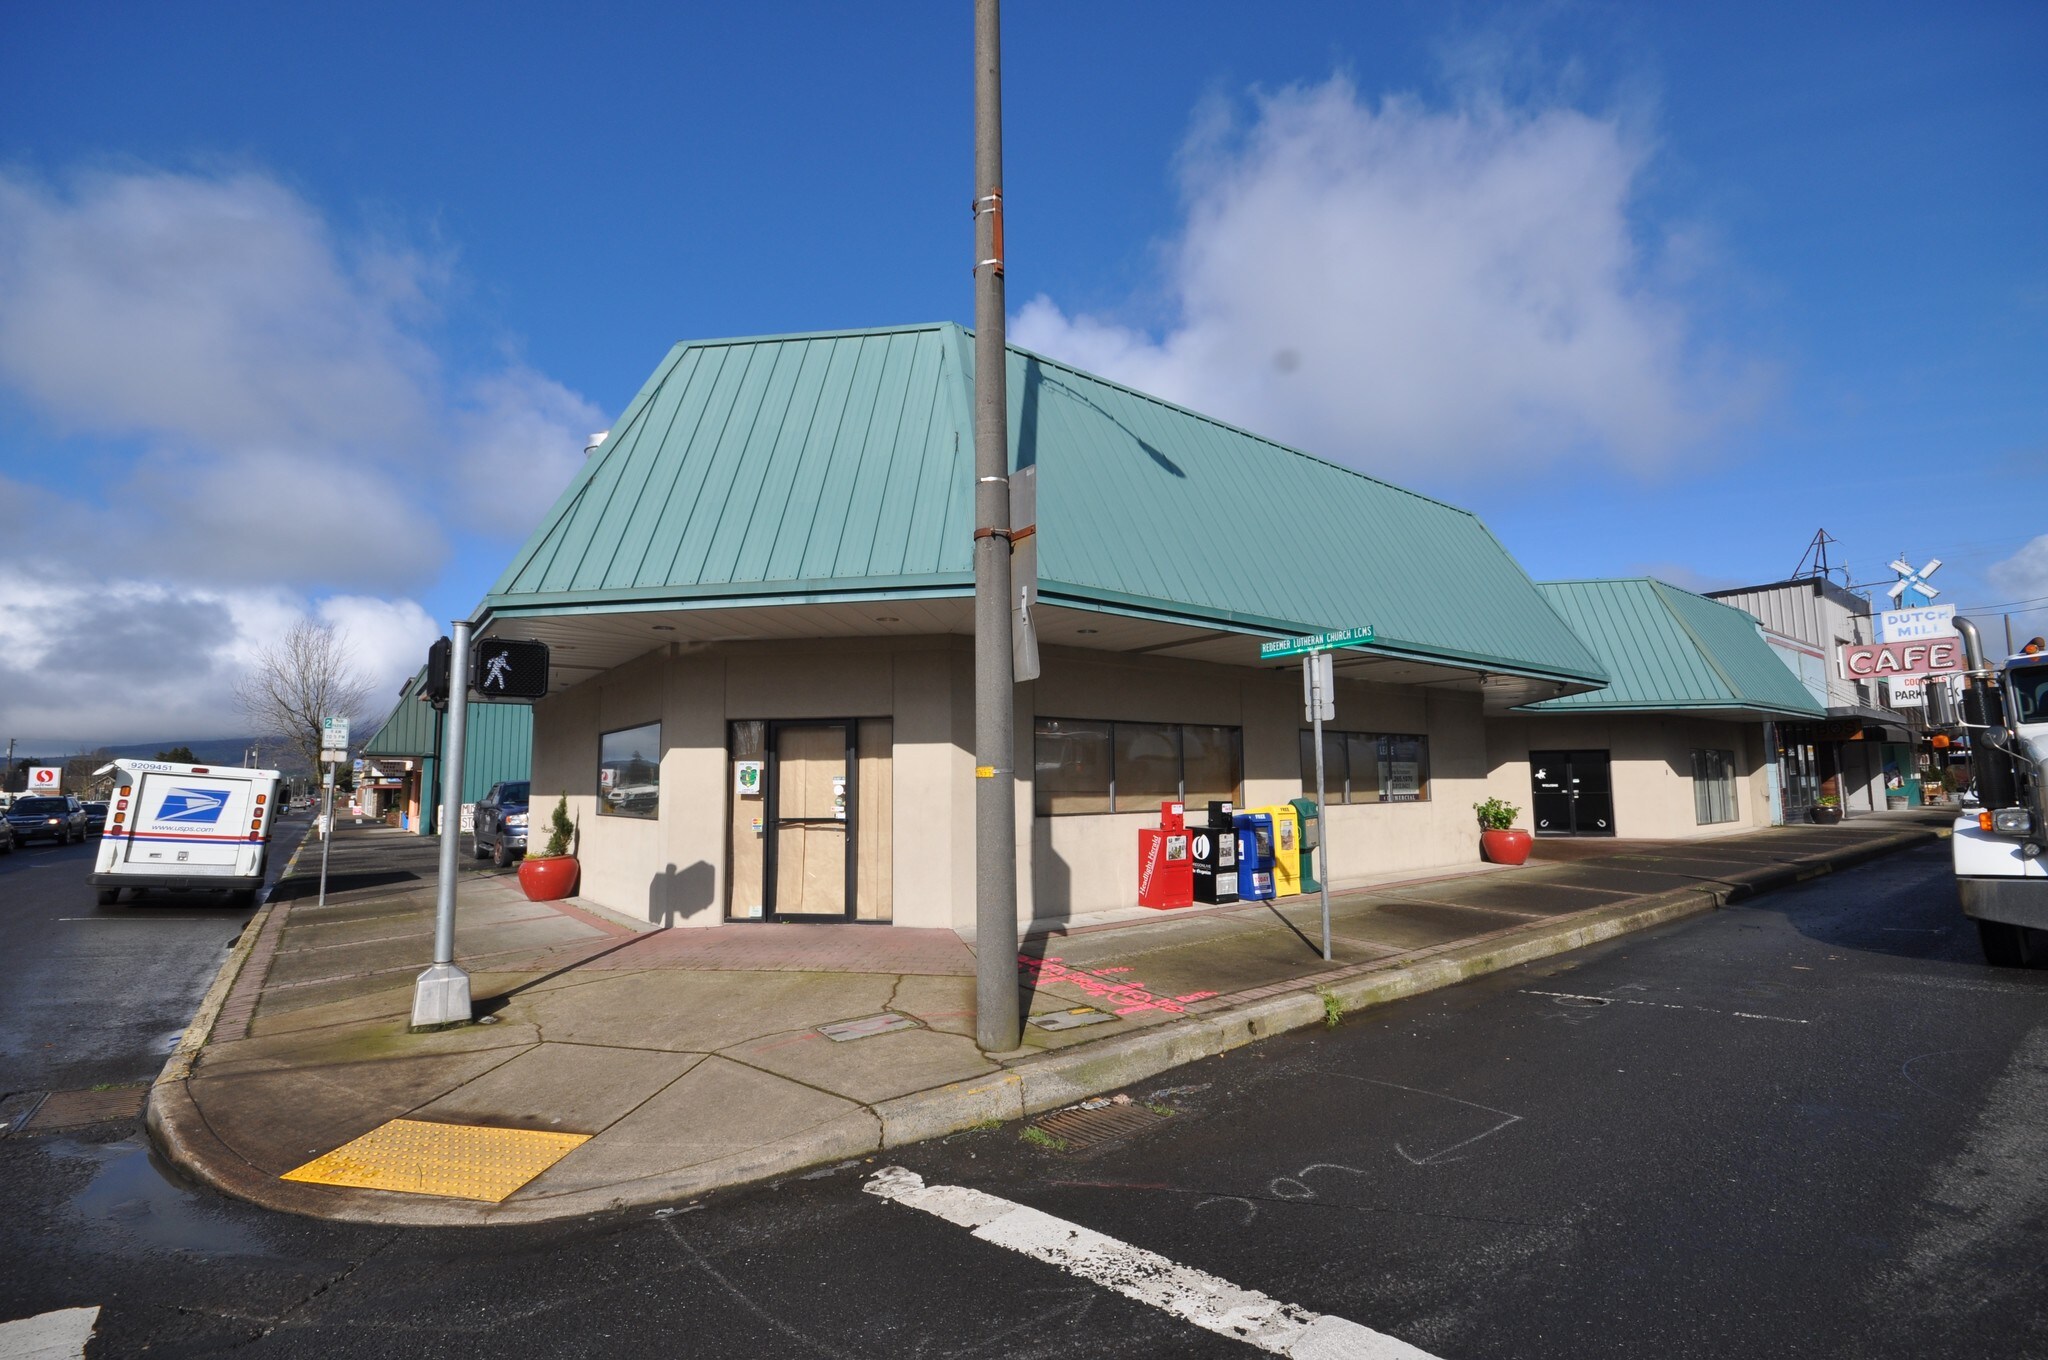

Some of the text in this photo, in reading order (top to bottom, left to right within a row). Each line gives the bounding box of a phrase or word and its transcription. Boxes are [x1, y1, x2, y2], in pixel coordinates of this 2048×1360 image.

[1888, 610, 1949, 625] DUTCH
[1262, 641, 1291, 653] REDEEMER
[1293, 634, 1324, 648] LUTHERAN
[1326, 630, 1350, 642] CHURCH
[1354, 626, 1372, 637] LCMS
[1849, 643, 1956, 674] CAFE
[325, 719, 331, 727] 2
[131, 762, 172, 771] 9209451
[151, 824, 214, 833] www.usps.com
[1139, 834, 1159, 896] Headlight Herald
